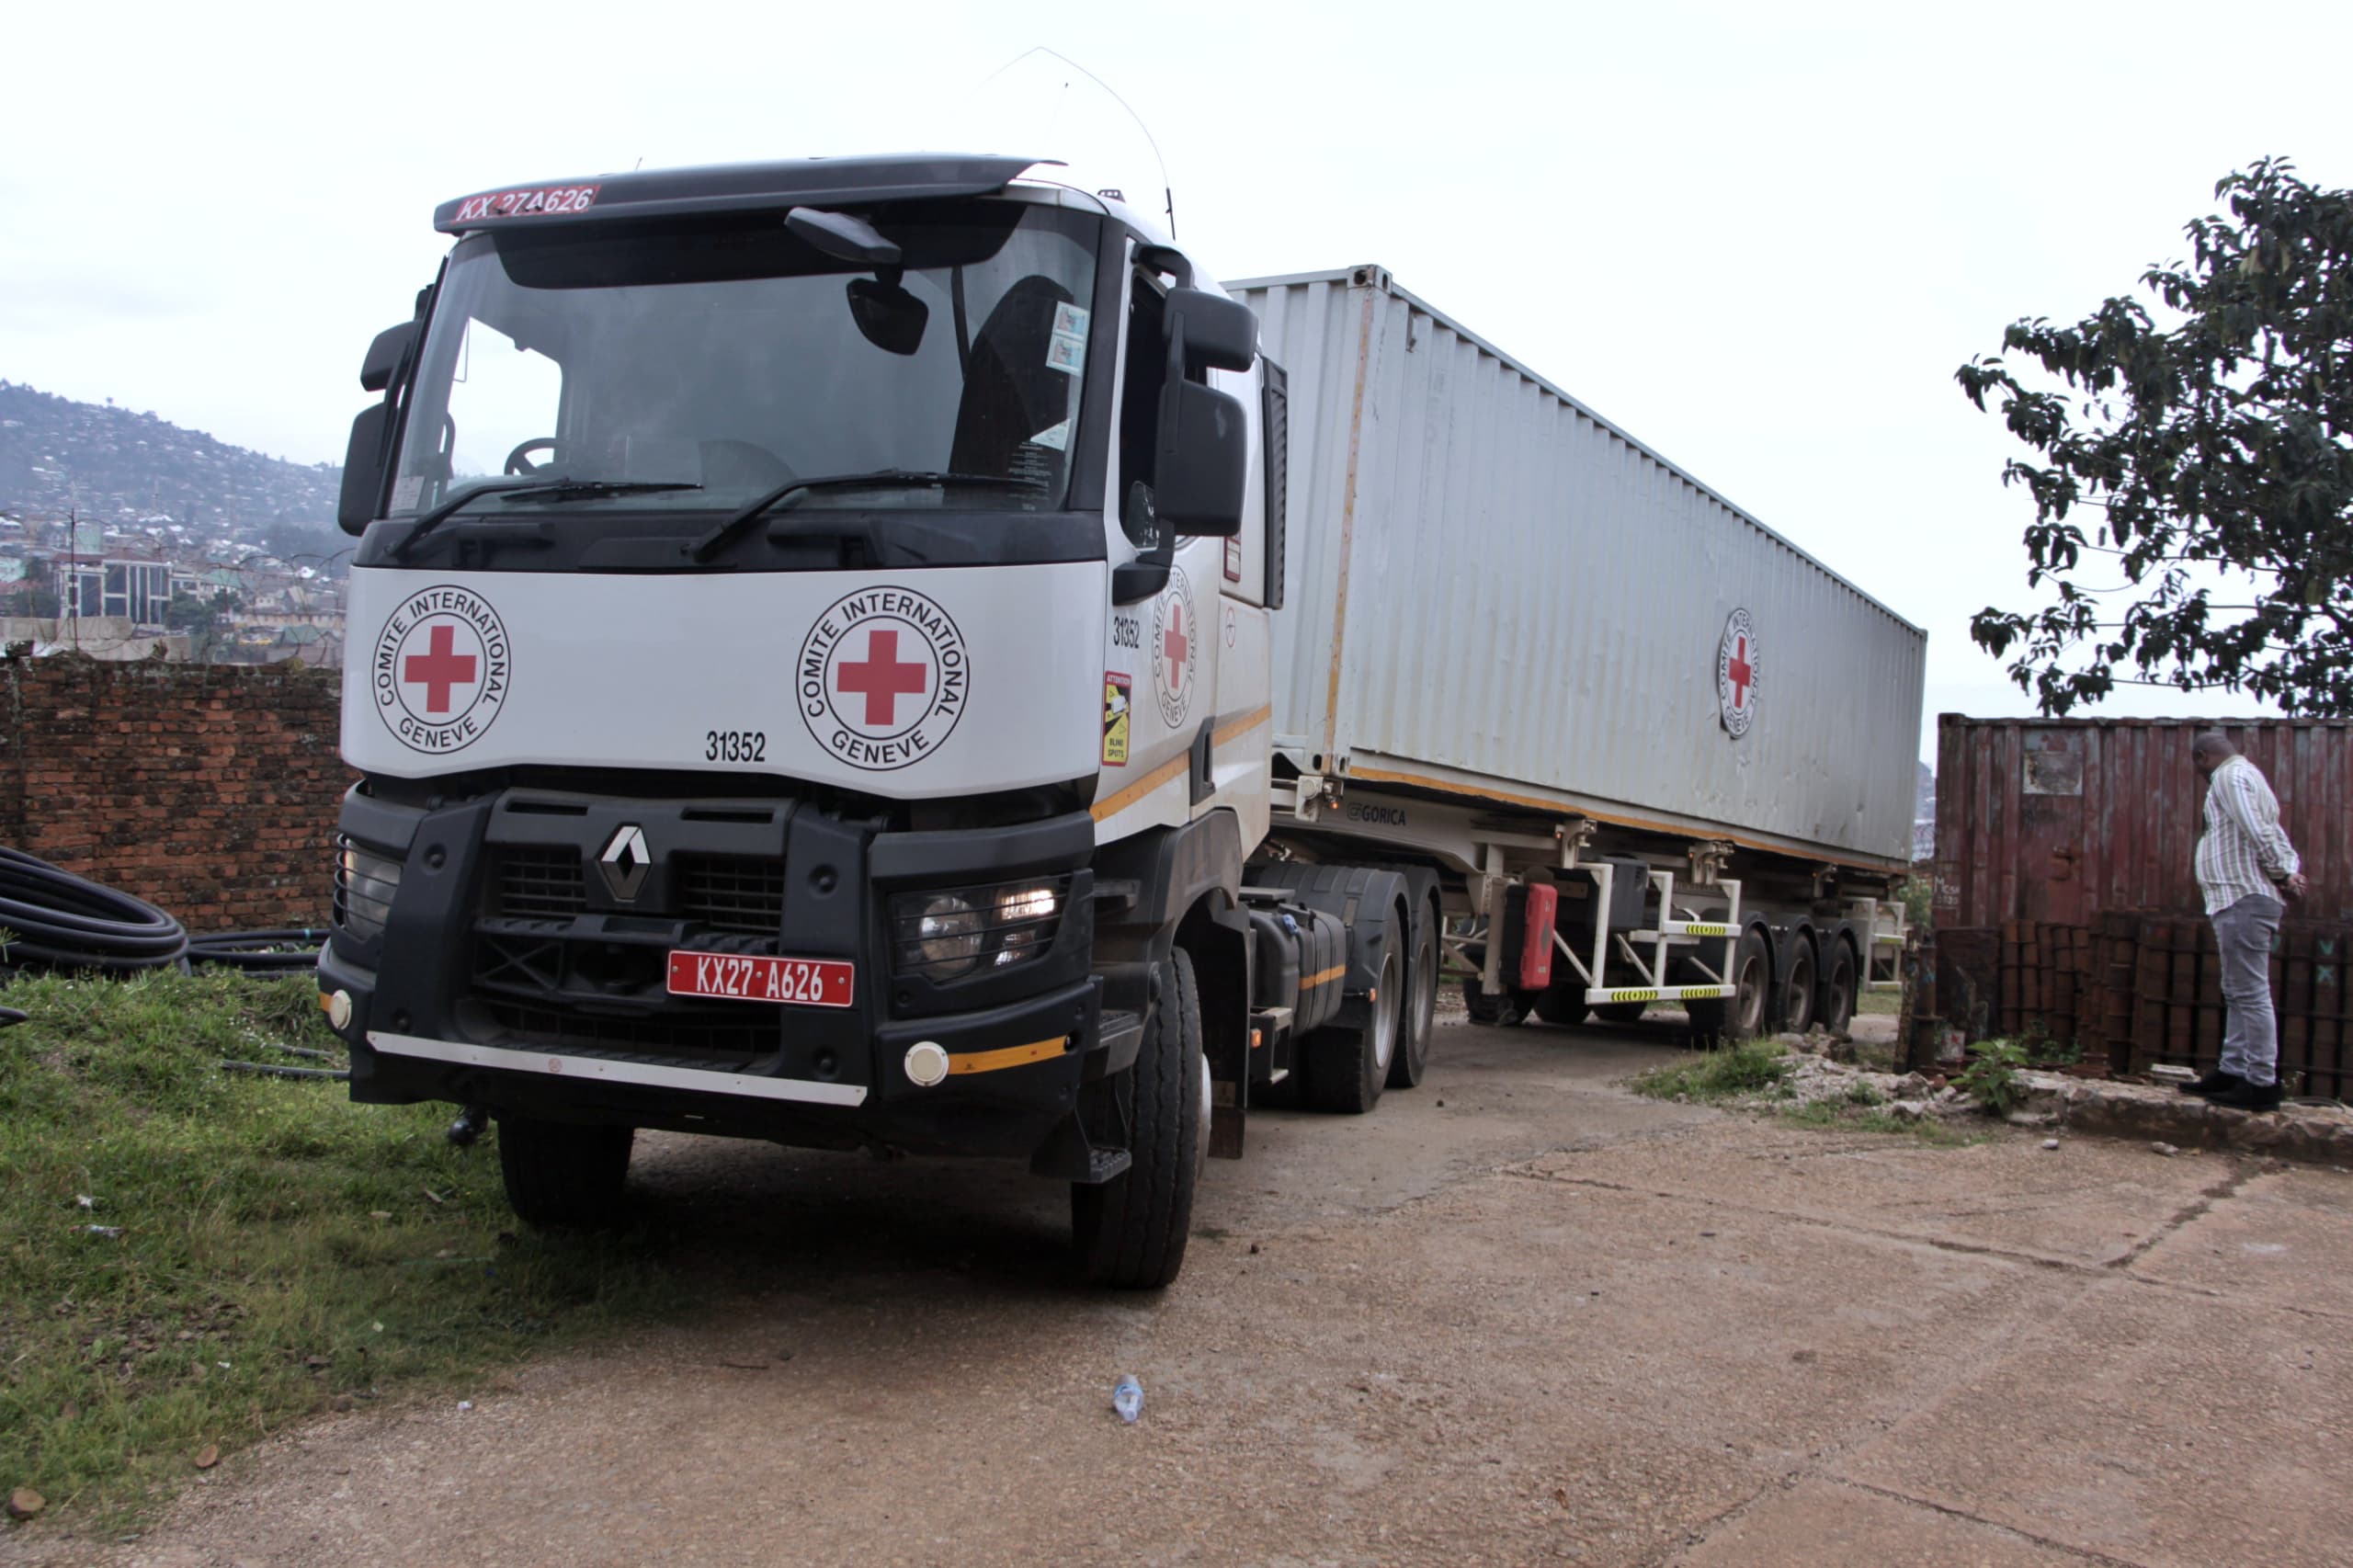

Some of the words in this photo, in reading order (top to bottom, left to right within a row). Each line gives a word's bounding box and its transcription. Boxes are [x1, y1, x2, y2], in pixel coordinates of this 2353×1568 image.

[456, 195, 496, 221] KX
[1113, 616, 1140, 649] 31352
[378, 617, 407, 707] COMITE
[409, 592, 506, 705] INTERNATIONAL
[802, 619, 840, 718] COMITE
[841, 593, 962, 718] INTERNATIONAL
[399, 716, 478, 748] GENEVE
[705, 730, 767, 763] 31352
[831, 729, 930, 765] GENEVE
[1361, 804, 1406, 826] GORICA
[697, 956, 754, 996] KX27
[766, 961, 824, 1002] A626
